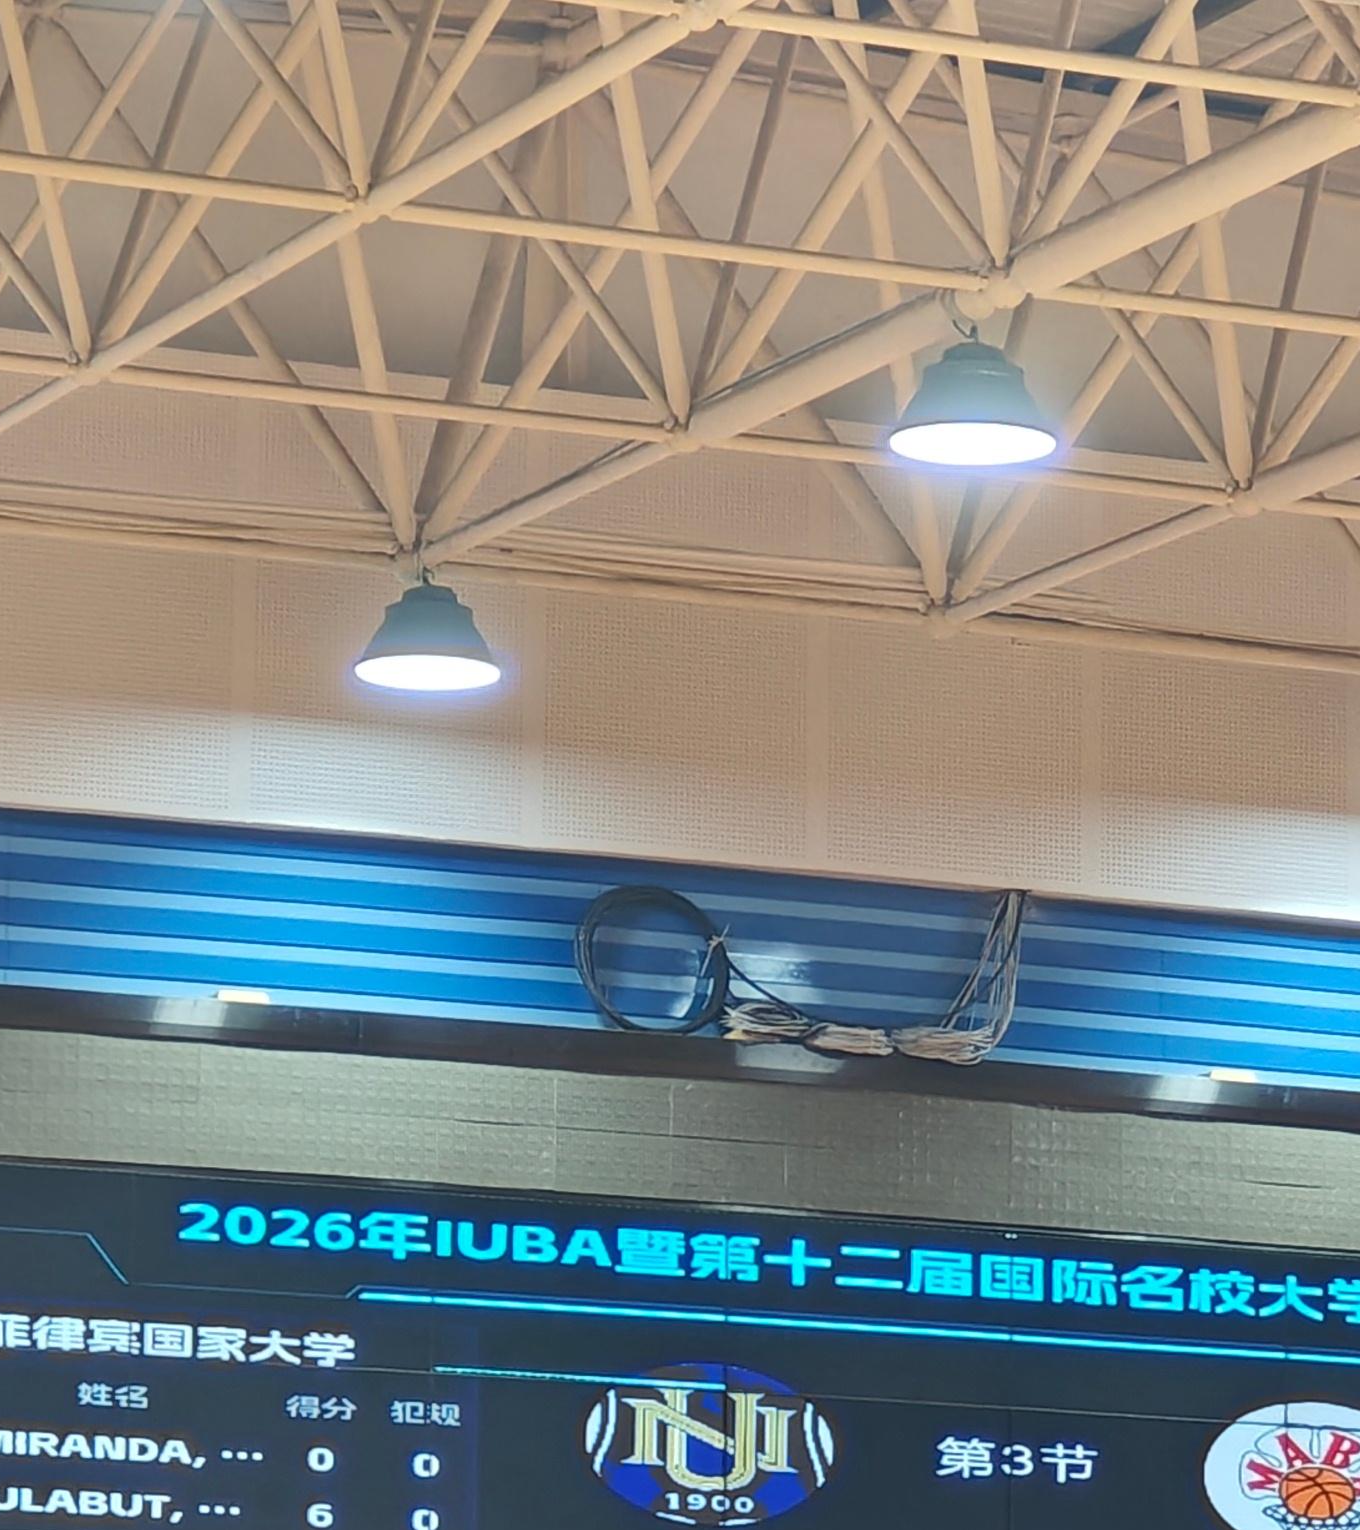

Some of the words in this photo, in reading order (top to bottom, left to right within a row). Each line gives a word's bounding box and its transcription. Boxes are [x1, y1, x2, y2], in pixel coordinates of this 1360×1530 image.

[78, 1383, 148, 1408] 姓名
[286, 1396, 356, 1420] 得分
[391, 1401, 460, 1426] 犯规
[308, 1448, 334, 1472] 0
[936, 1437, 1097, 1483] 第3节
[665, 1493, 754, 1514] 1900
[307, 1504, 333, 1528] 6
